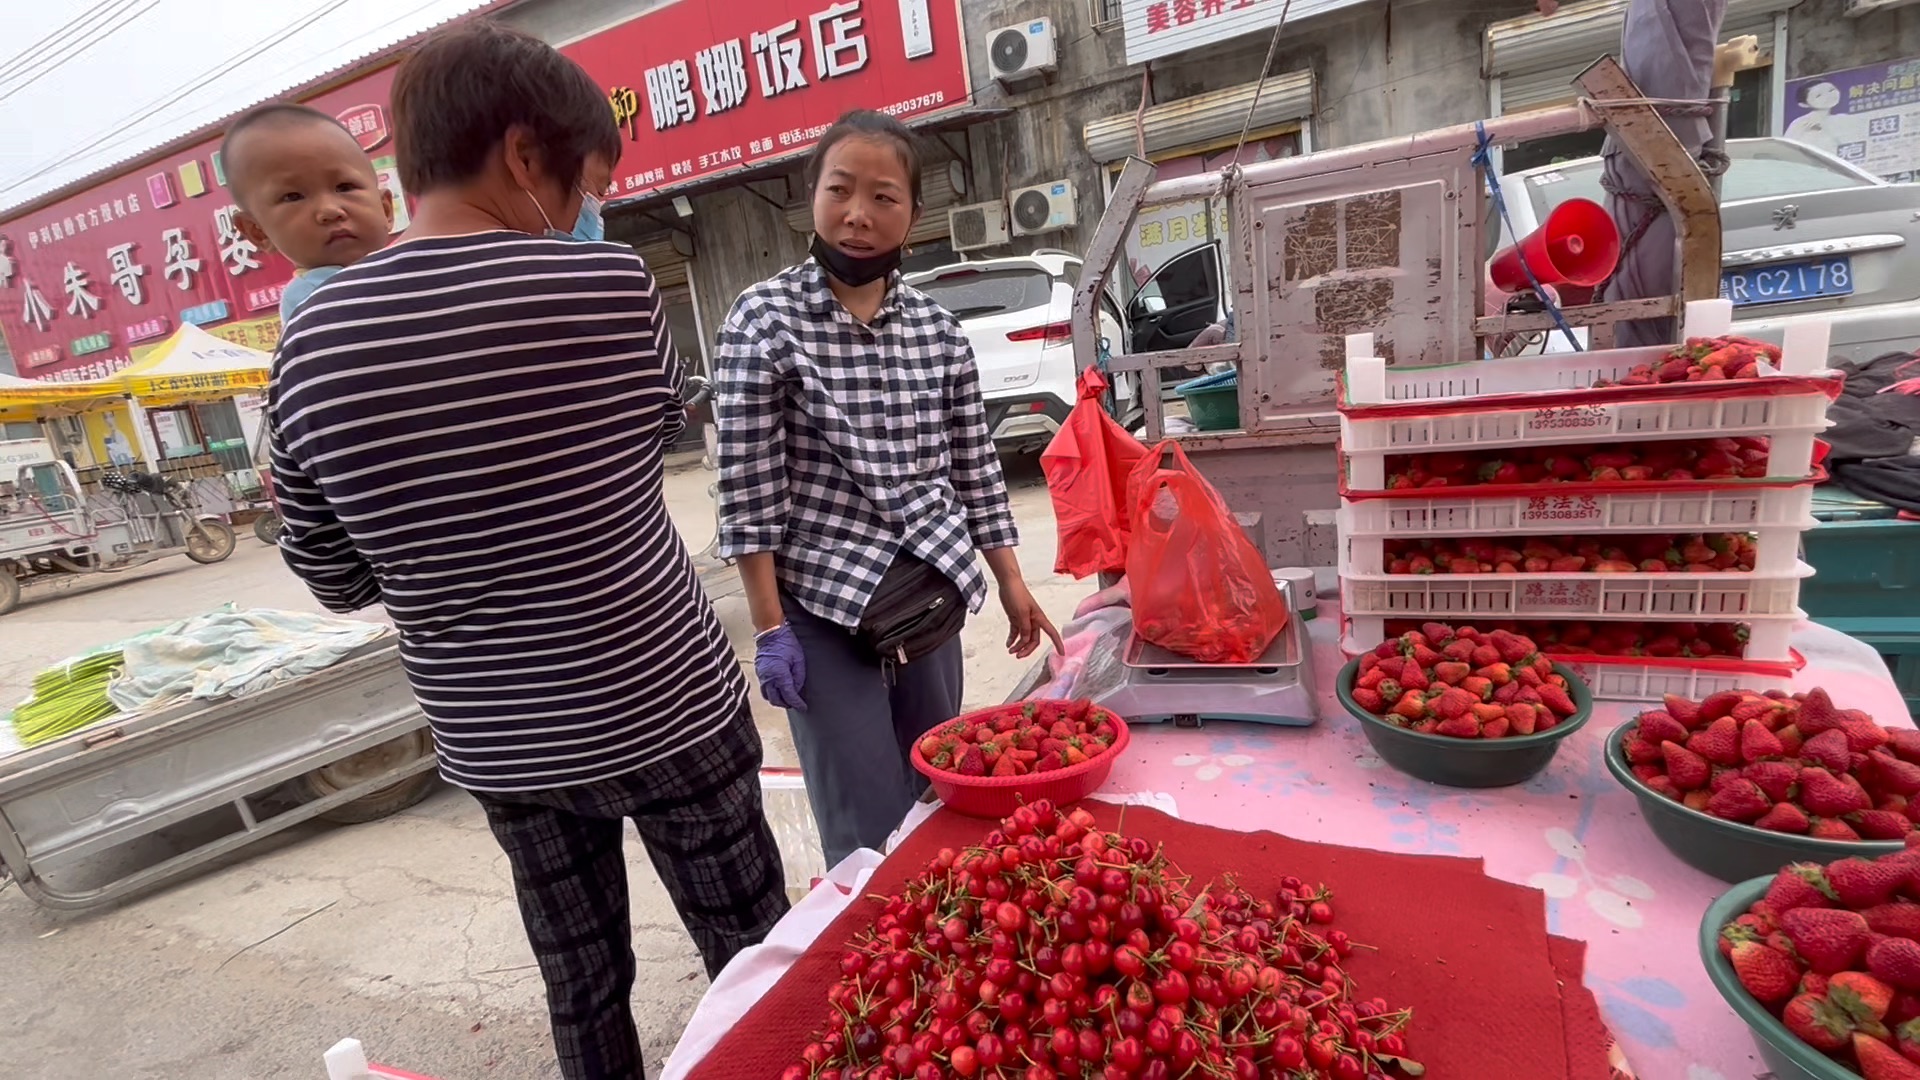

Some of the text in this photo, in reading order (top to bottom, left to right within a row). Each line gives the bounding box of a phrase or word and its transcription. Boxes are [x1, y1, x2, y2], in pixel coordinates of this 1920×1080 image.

[644, 1, 869, 131] 鹏娜饭店
[671, 159, 692, 176] 快餐
[699, 145, 742, 169] 手工水饺
[1528, 416, 1611, 430] 13953083517
[1521, 509, 1601, 520] 13953083517
